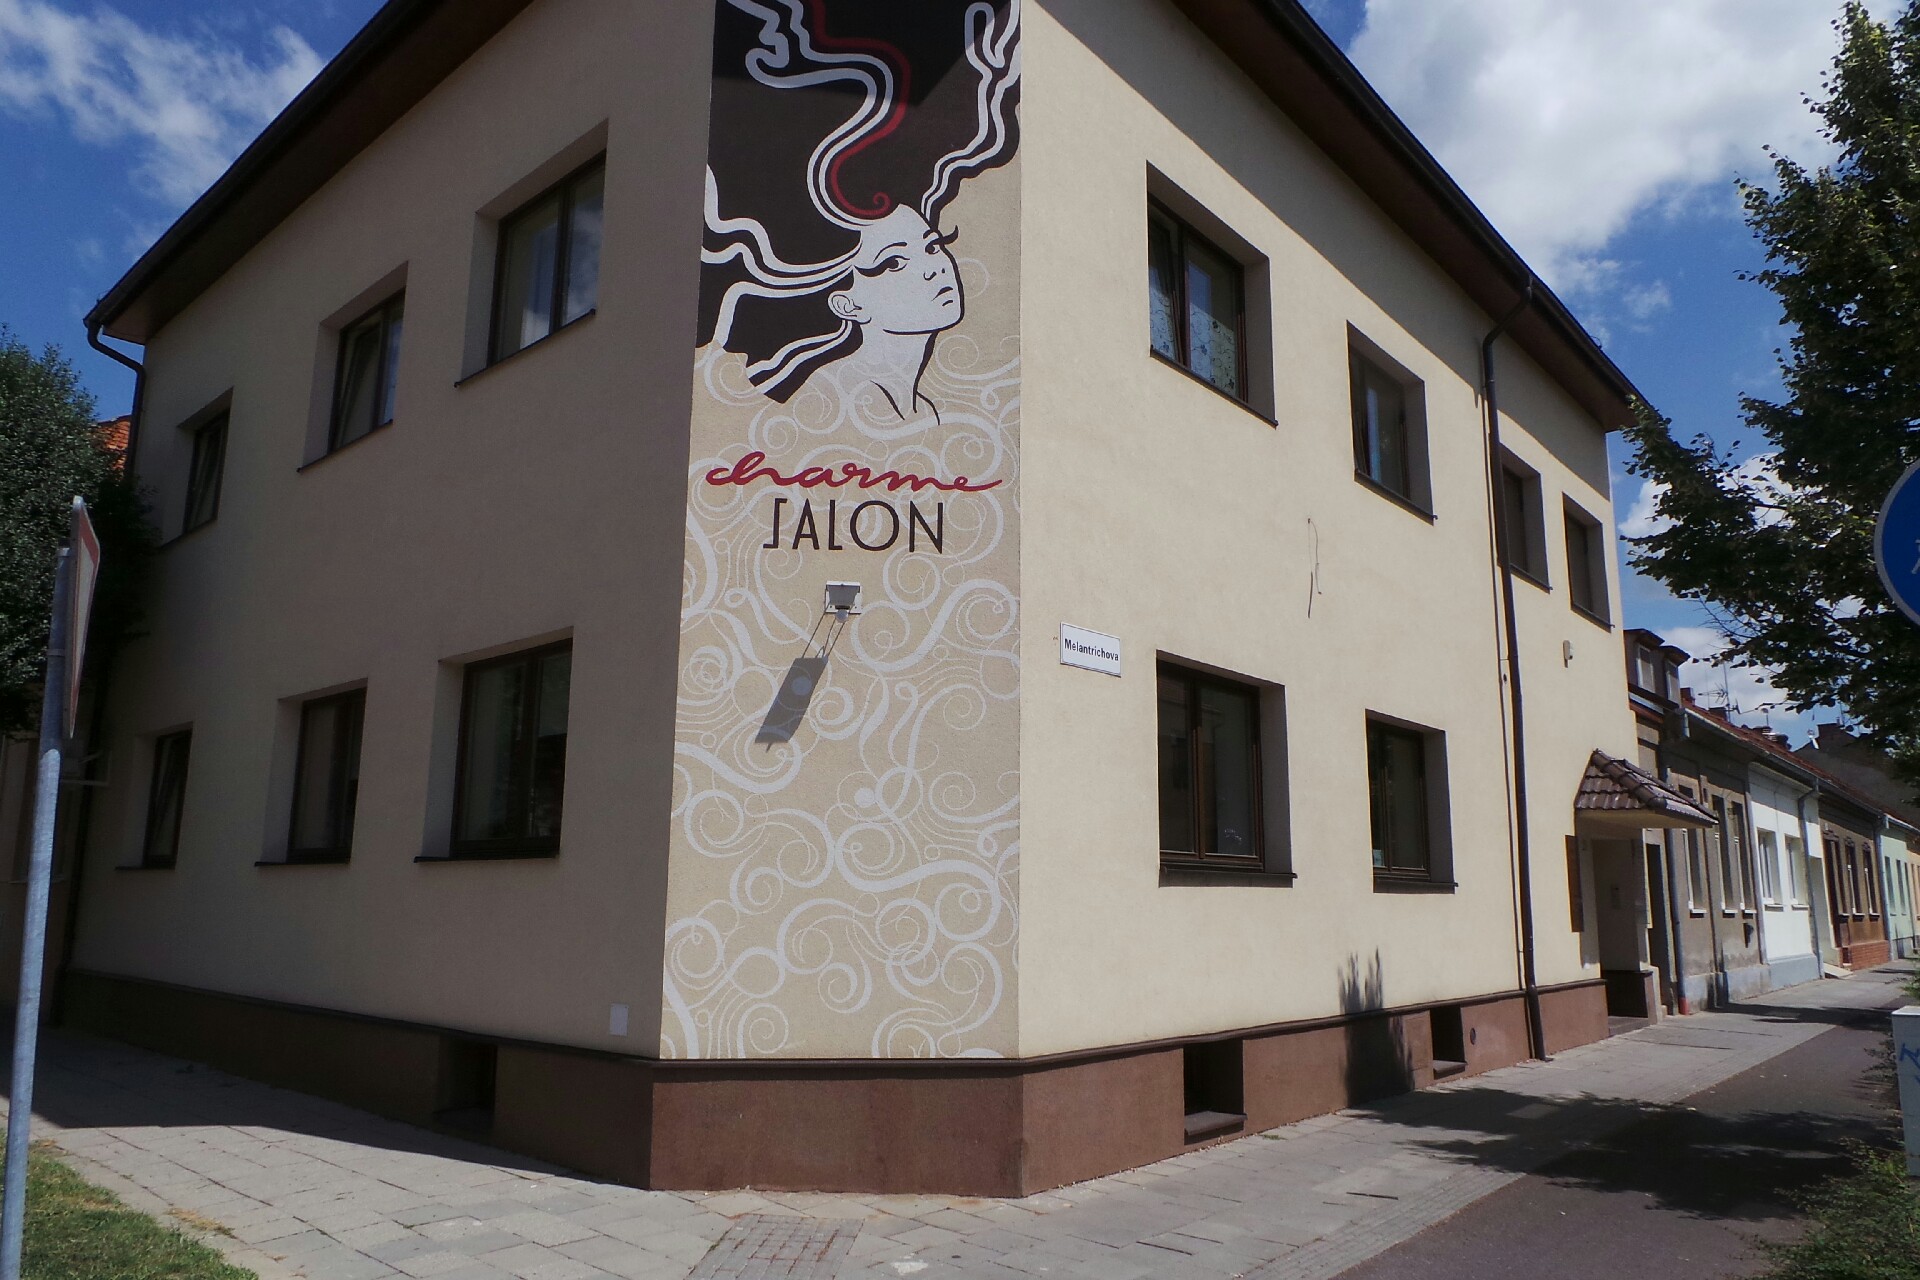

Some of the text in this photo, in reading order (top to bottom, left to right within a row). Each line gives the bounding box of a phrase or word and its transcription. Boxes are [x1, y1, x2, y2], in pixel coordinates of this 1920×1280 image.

[705, 452, 1003, 492] charme
[763, 498, 944, 554] SALON
[1065, 638, 1119, 661] Melantrichova
